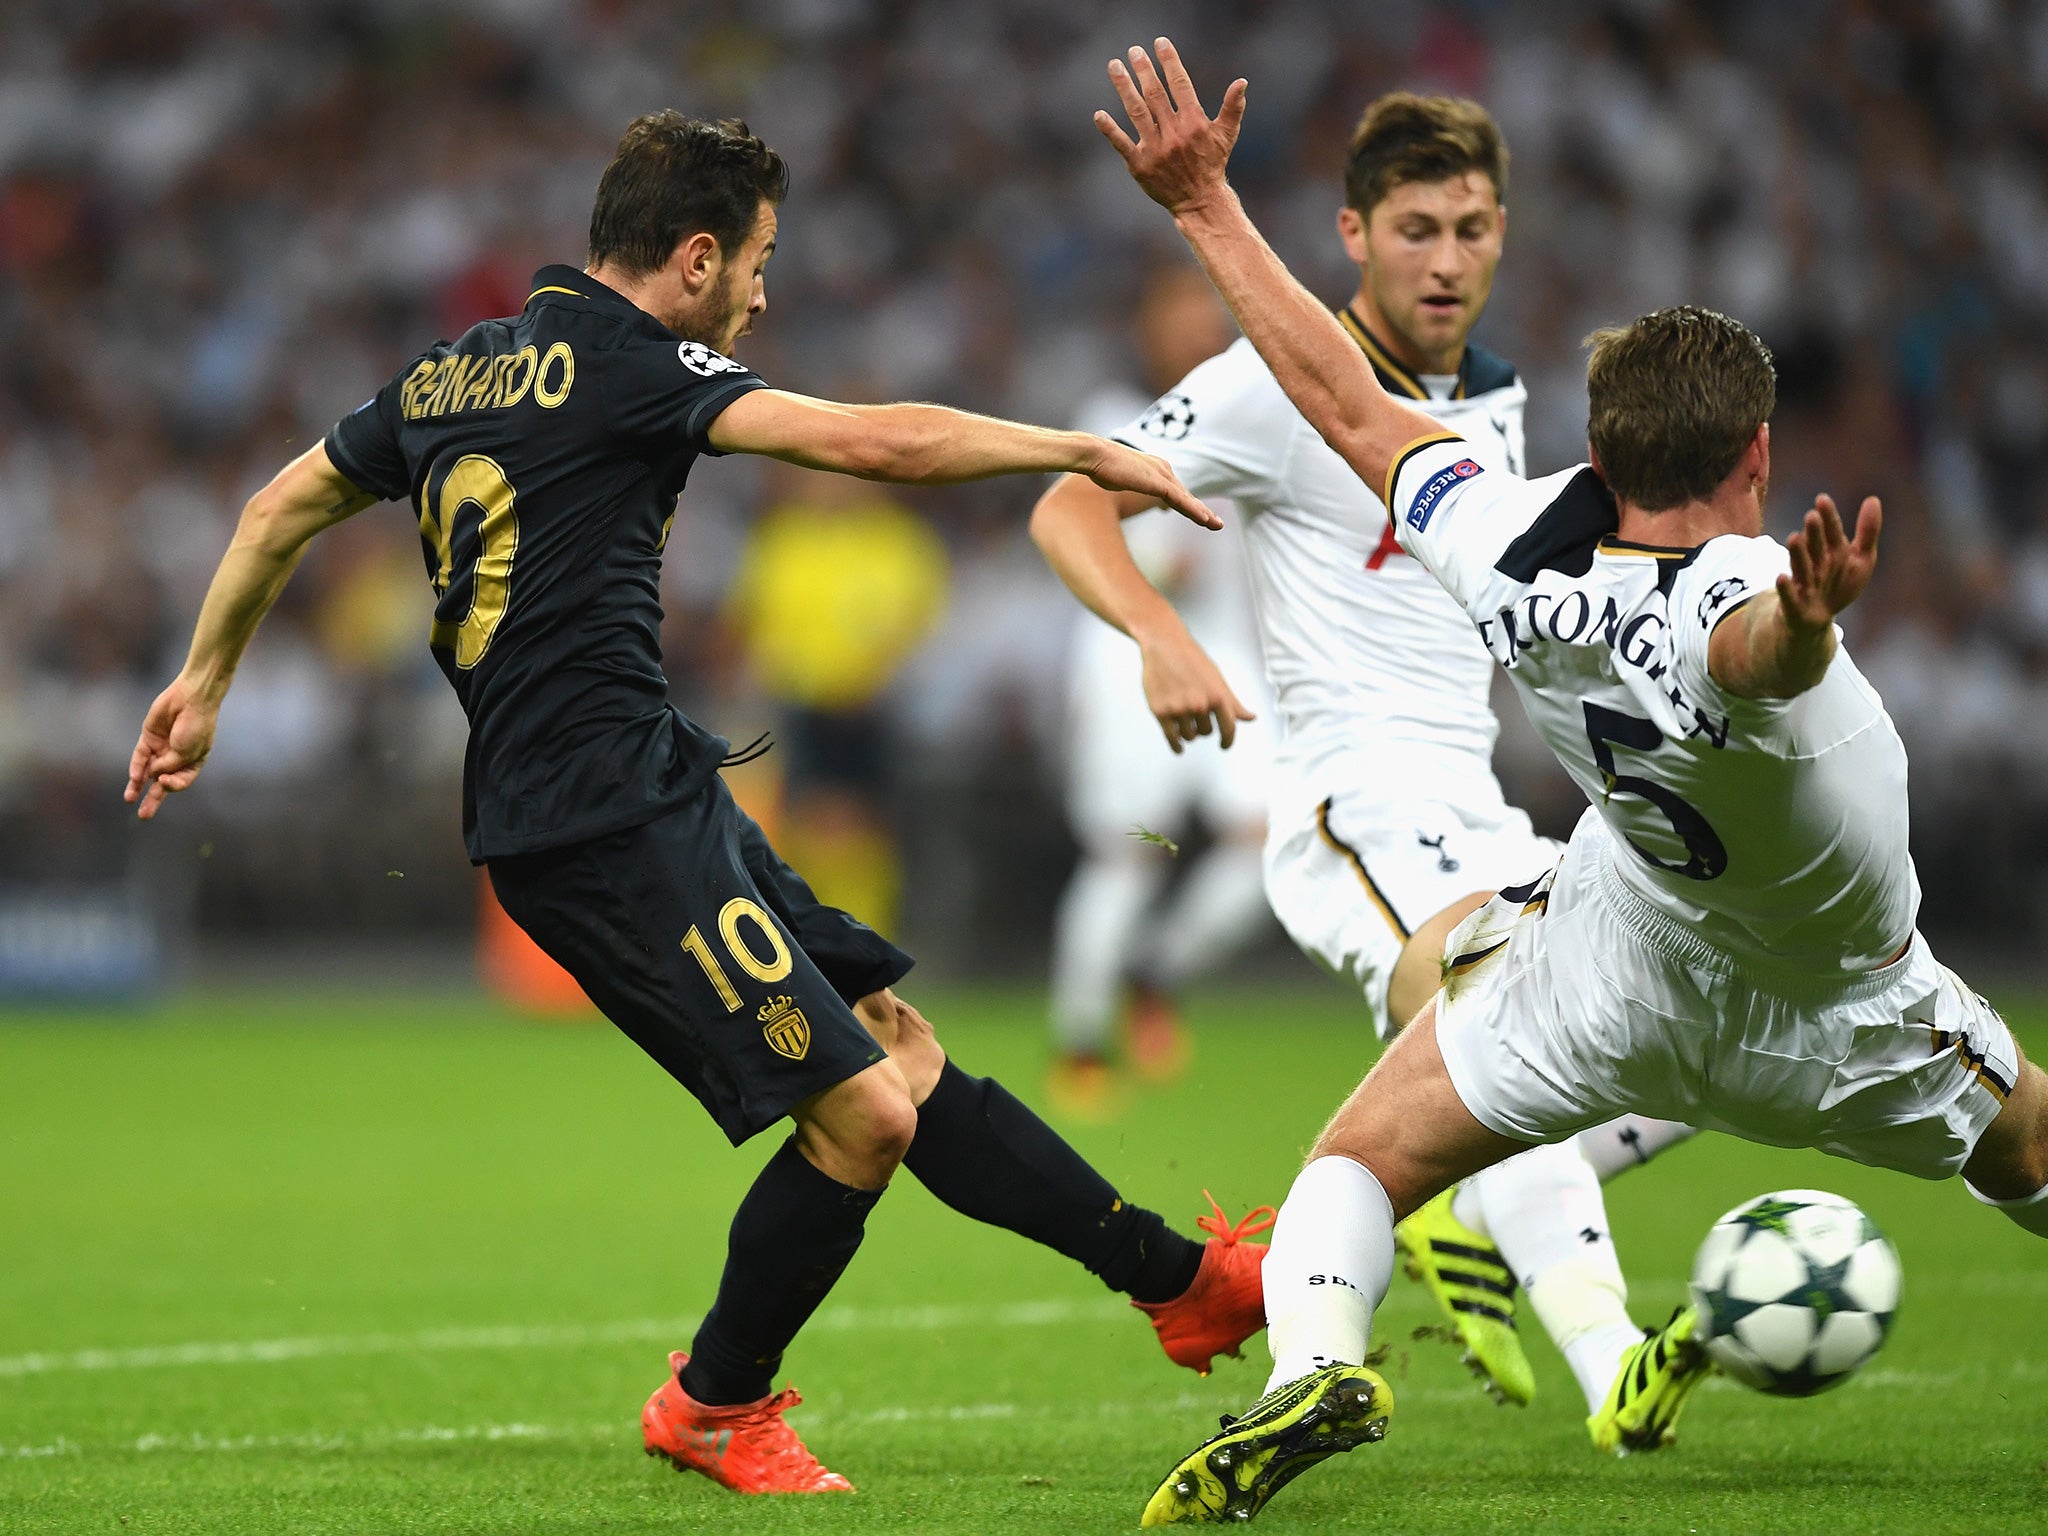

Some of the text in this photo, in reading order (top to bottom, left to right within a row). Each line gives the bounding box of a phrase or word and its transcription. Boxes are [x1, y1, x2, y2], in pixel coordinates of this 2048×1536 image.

[401, 341, 576, 421] BERNARDO
[1410, 471, 1458, 529] RESPECT
[1581, 699, 1729, 882] 5
[680, 897, 793, 1013] 10
